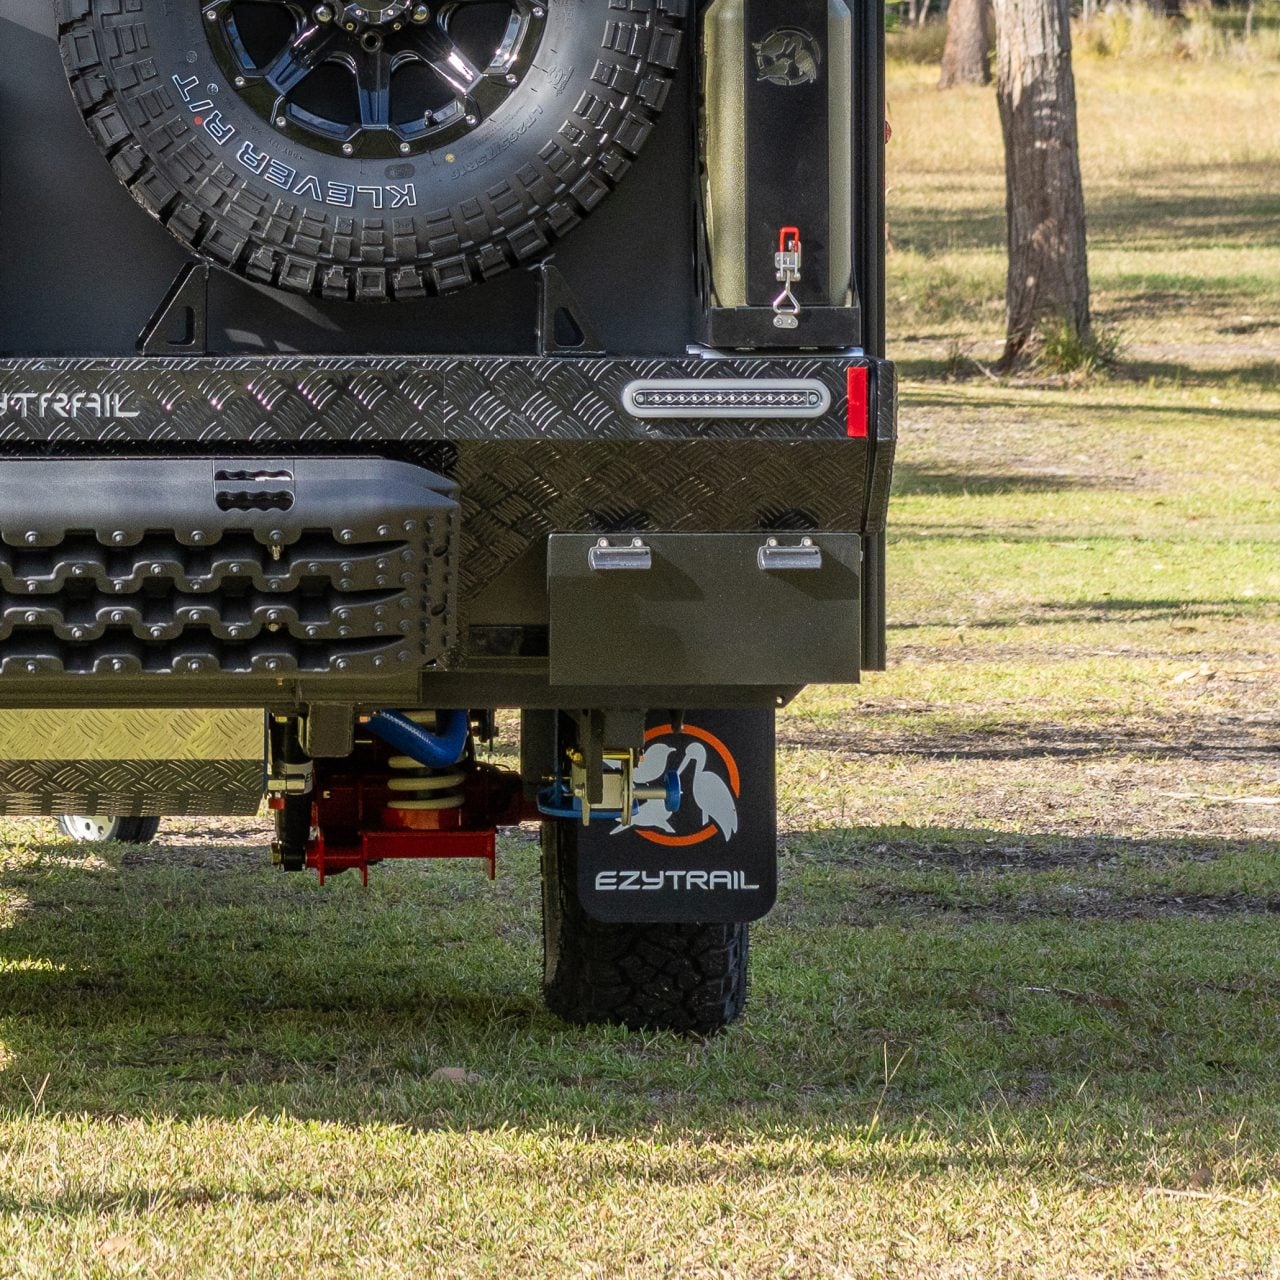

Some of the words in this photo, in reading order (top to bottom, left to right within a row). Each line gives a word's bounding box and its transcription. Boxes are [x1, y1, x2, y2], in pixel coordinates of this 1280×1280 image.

[173, 72, 236, 145] R/T
[236, 140, 418, 209] KLEVER
[595, 870, 760, 891] EZYTRAIL
